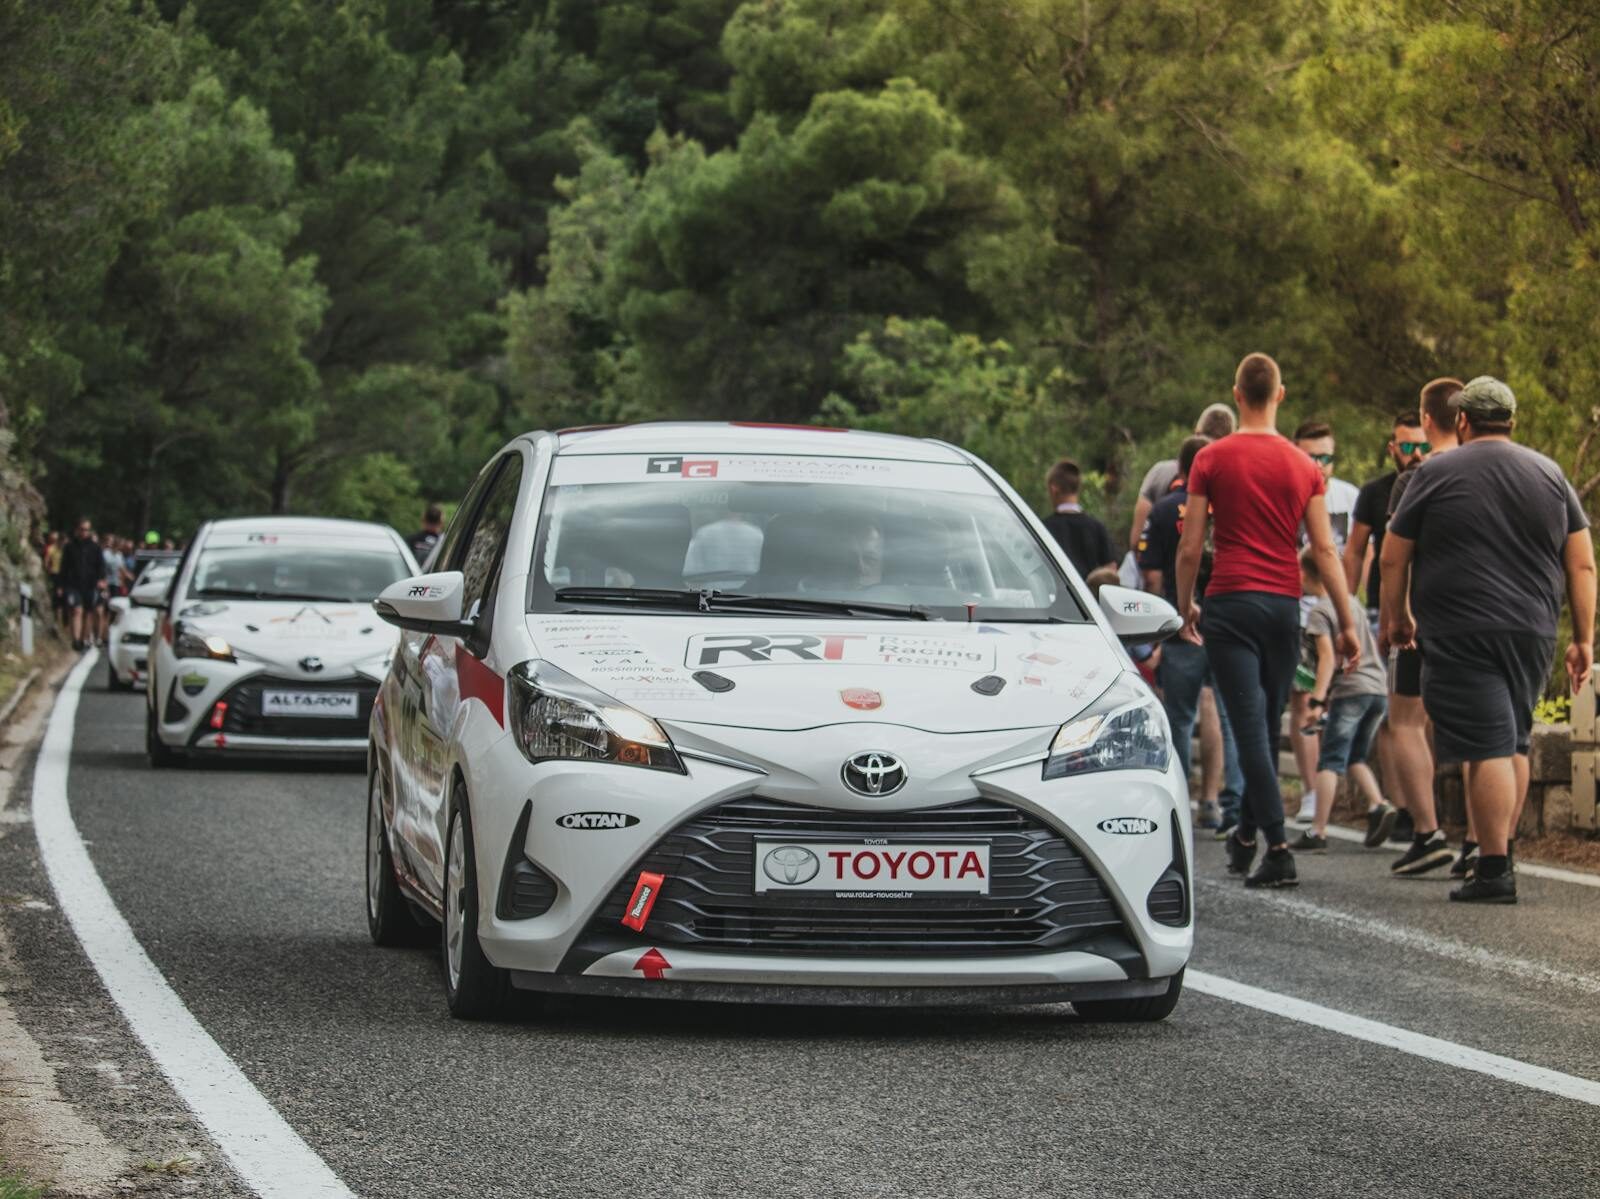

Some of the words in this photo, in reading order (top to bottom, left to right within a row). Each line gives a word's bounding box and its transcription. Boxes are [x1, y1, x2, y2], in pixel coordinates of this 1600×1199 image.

[408, 586, 430, 597] RRT
[1123, 601, 1141, 613] RRT
[699, 635, 867, 665] RRT
[879, 645, 982, 662] Racing
[878, 654, 958, 667] Team
[270, 694, 352, 707] ALTARON
[562, 814, 626, 828] OKTAN
[1102, 819, 1151, 833] OKTAN
[864, 838, 888, 846] TOYOTA
[828, 850, 985, 881] TOYOTA
